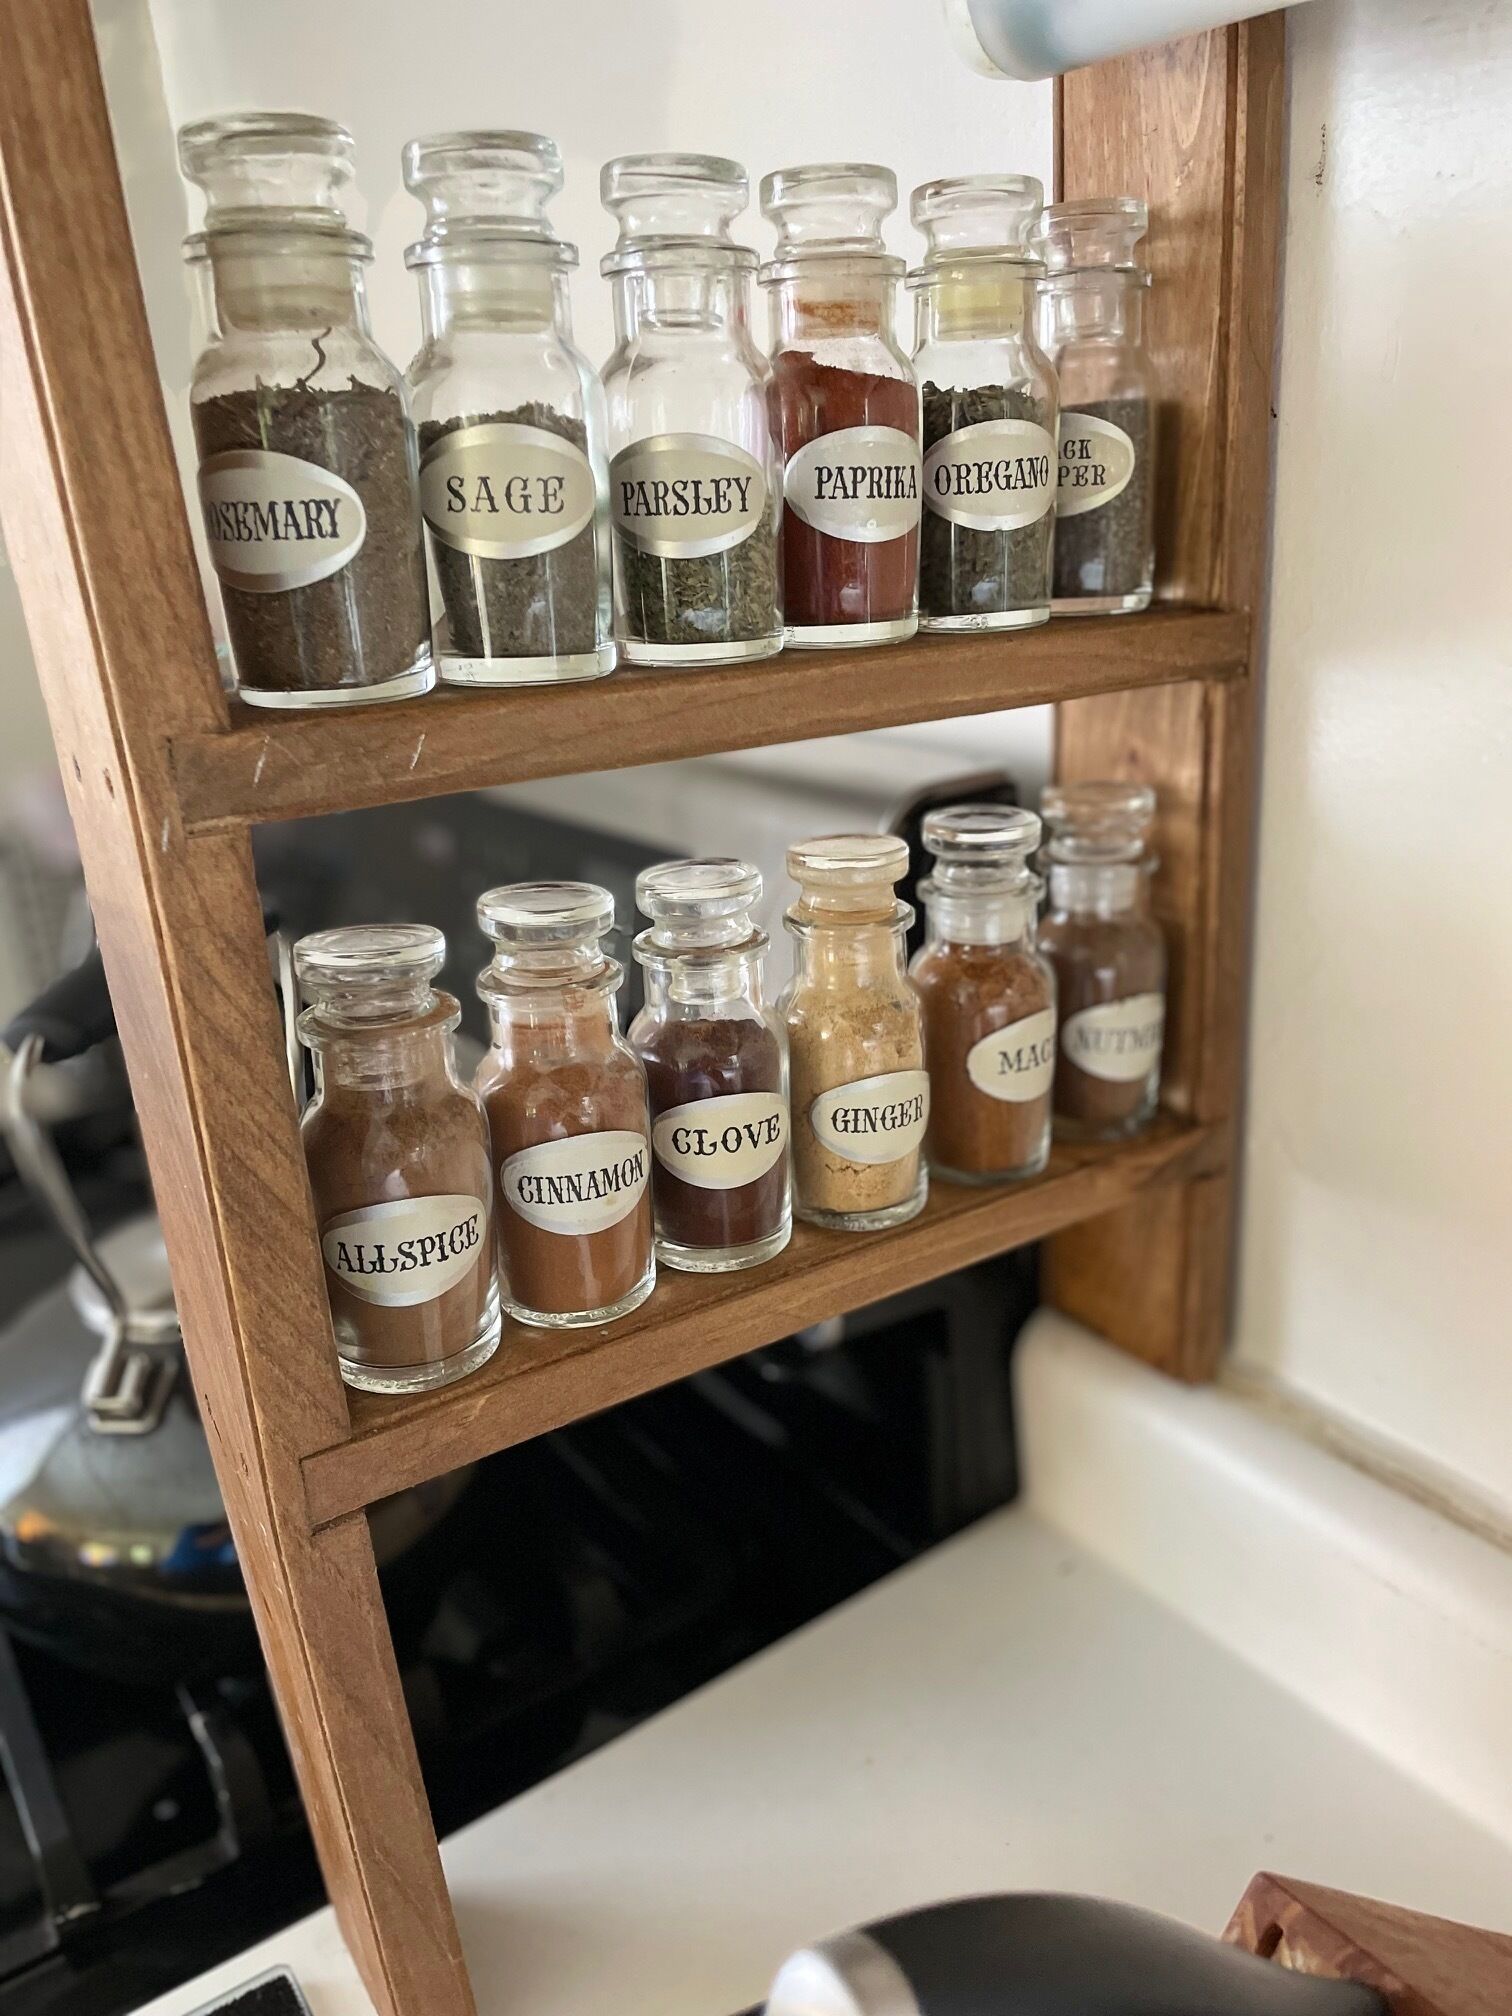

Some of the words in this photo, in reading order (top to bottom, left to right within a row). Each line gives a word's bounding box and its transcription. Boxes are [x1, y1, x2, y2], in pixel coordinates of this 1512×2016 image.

[446, 475, 565, 514] SAGE
[620, 476, 752, 516] PARSLEY
[814, 465, 917, 500] PAPRIKA
[934, 455, 1049, 496] OREGANO
[997, 1035, 1056, 1076] MAC
[830, 1093, 923, 1134] GINGER
[671, 1113, 780, 1156] CLOVE
[517, 1149, 644, 1205] CINNAMON
[336, 1213, 479, 1274] ALLSPICE
